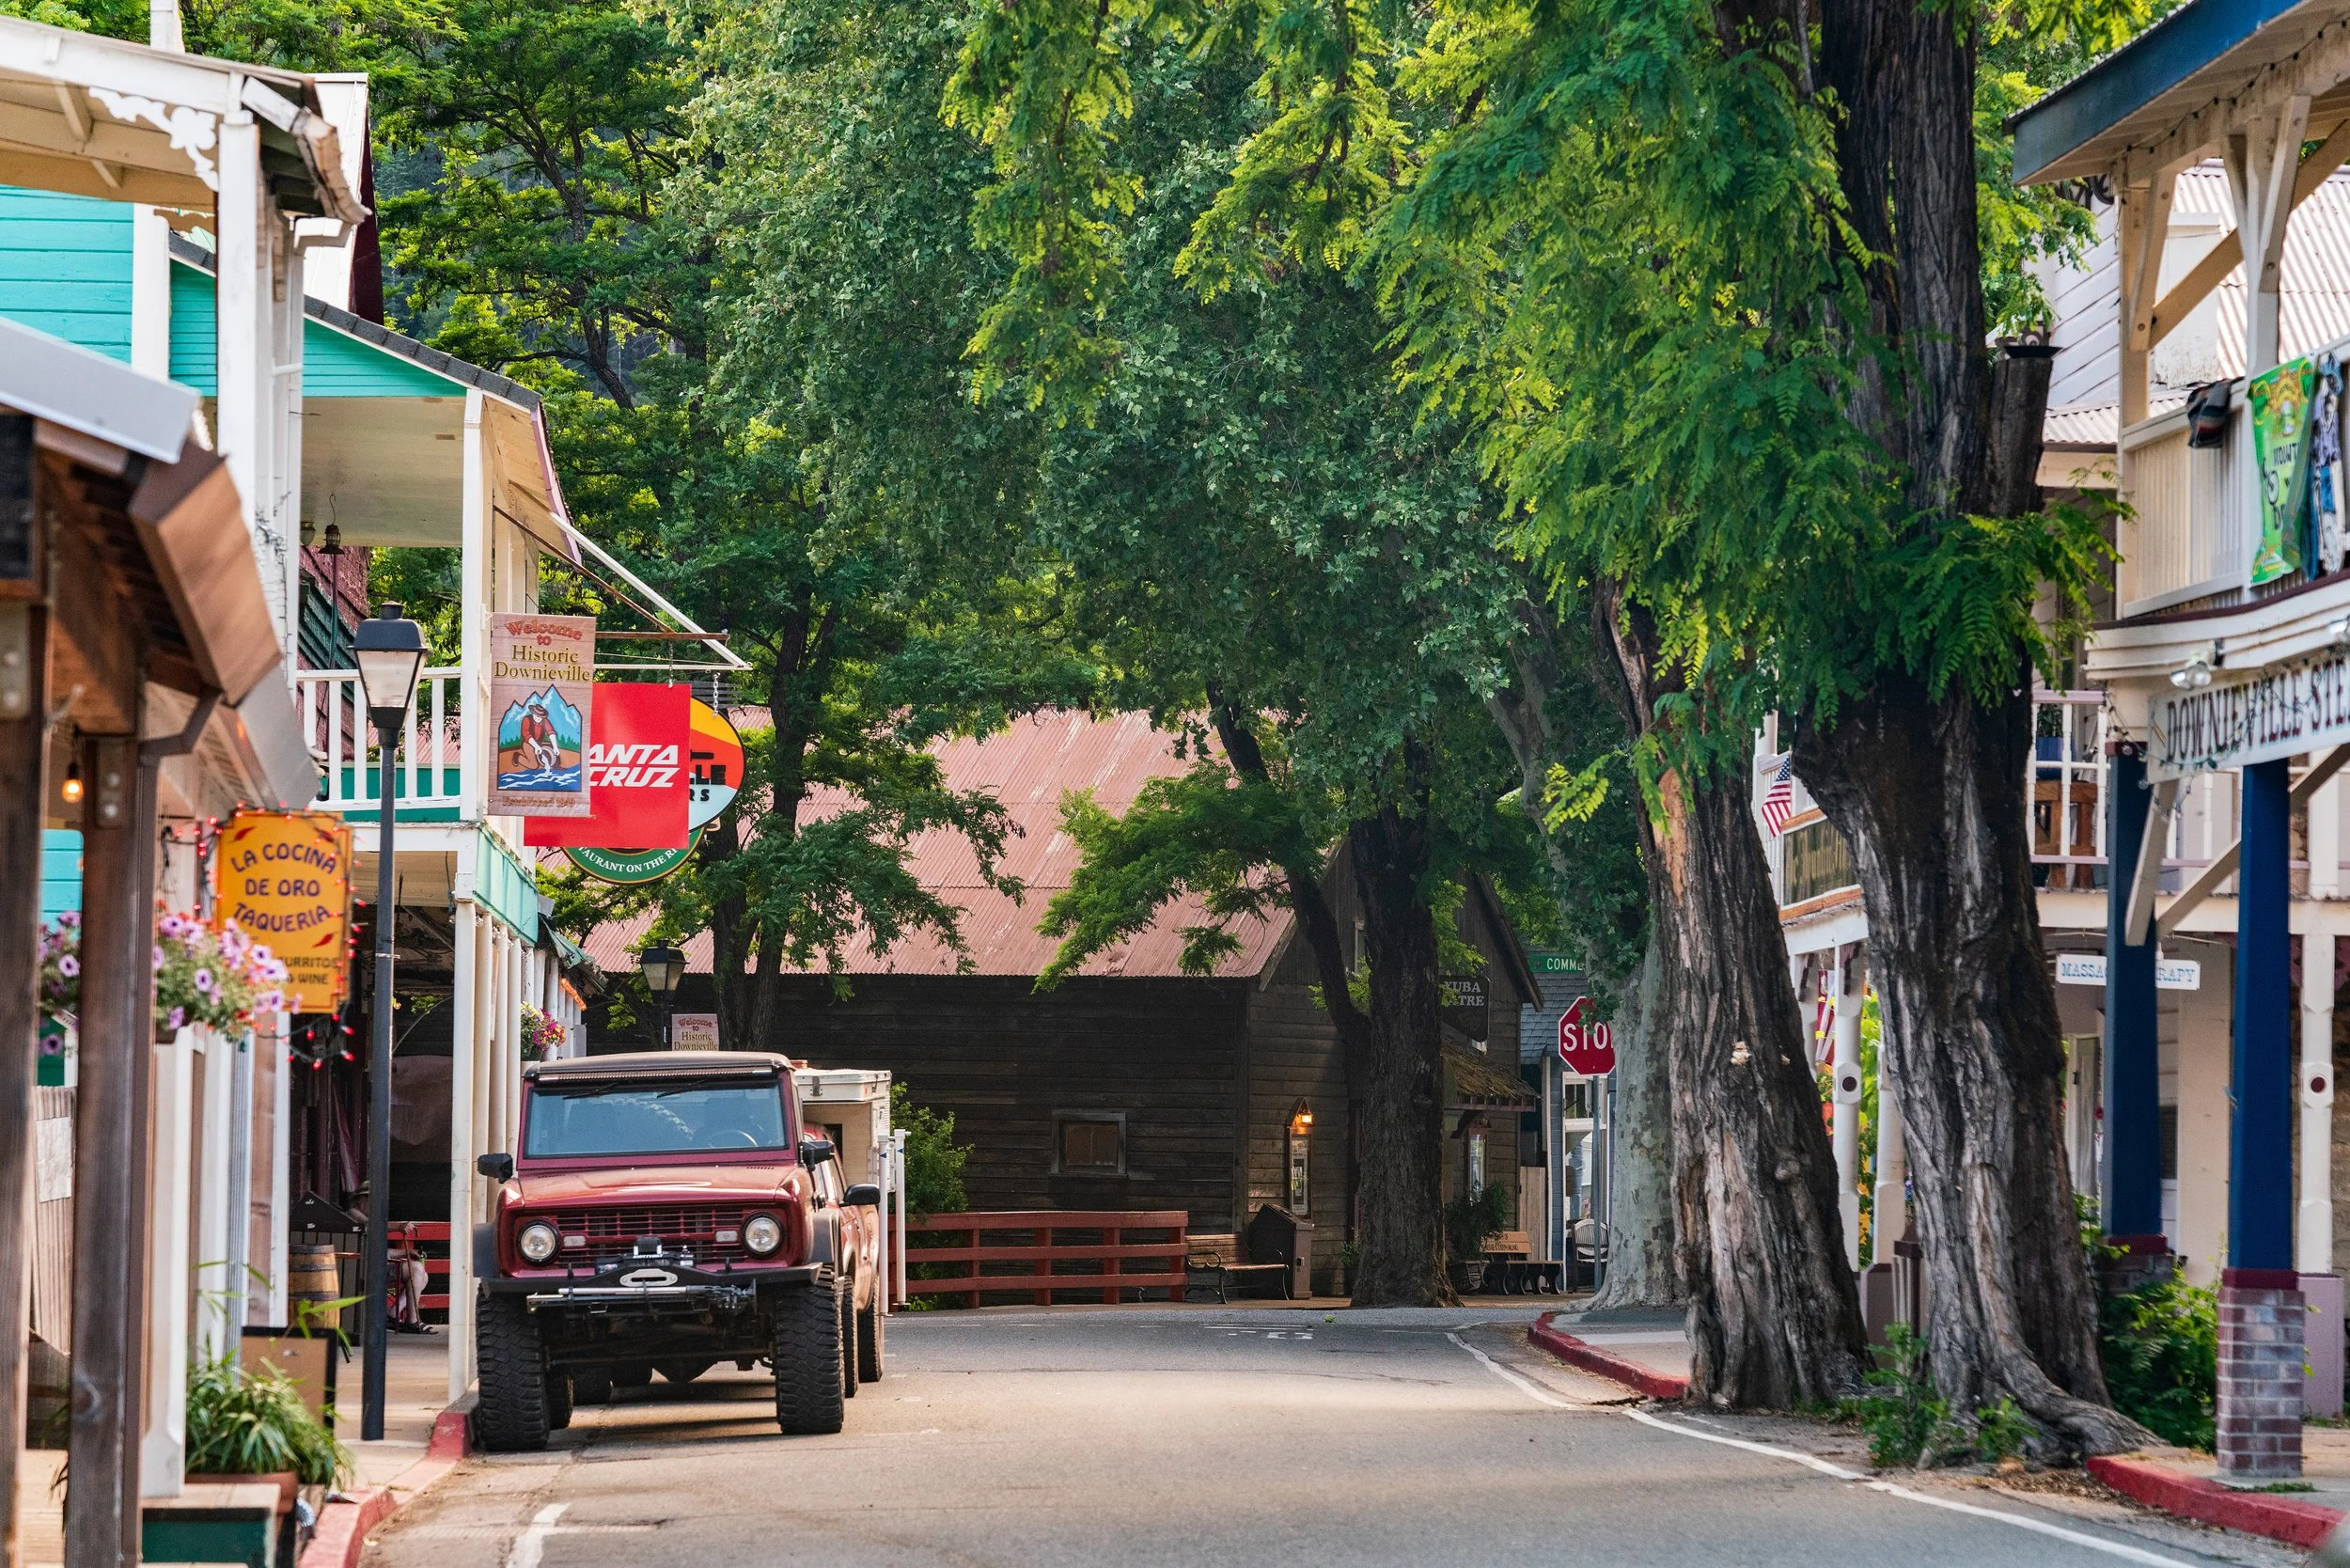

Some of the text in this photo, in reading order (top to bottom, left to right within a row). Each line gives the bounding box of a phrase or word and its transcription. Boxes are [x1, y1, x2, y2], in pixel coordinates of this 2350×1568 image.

[505, 619, 582, 640] Welcome
[537, 635, 552, 646] to
[511, 644, 579, 664] Historic
[494, 661, 590, 682] Downieville
[2168, 657, 2350, 761] DOWNIEVILLE STE
[589, 766, 681, 788] CRUZ
[231, 843, 337, 874] LA COCINA
[626, 864, 643, 873] ON
[644, 855, 666, 870] THE
[244, 878, 321, 897] DE ORO
[233, 902, 331, 933] TAQUERIA
[278, 956, 339, 969] URRITOS
[2061, 963, 2107, 979] MASSA
[297, 973, 329, 985] WINE
[1449, 995, 1485, 1007] TRE
[677, 1018, 713, 1027] Welcome
[682, 1031, 713, 1041] Historic
[1563, 1022, 1614, 1052] STO
[674, 1041, 718, 1051] Downieville
